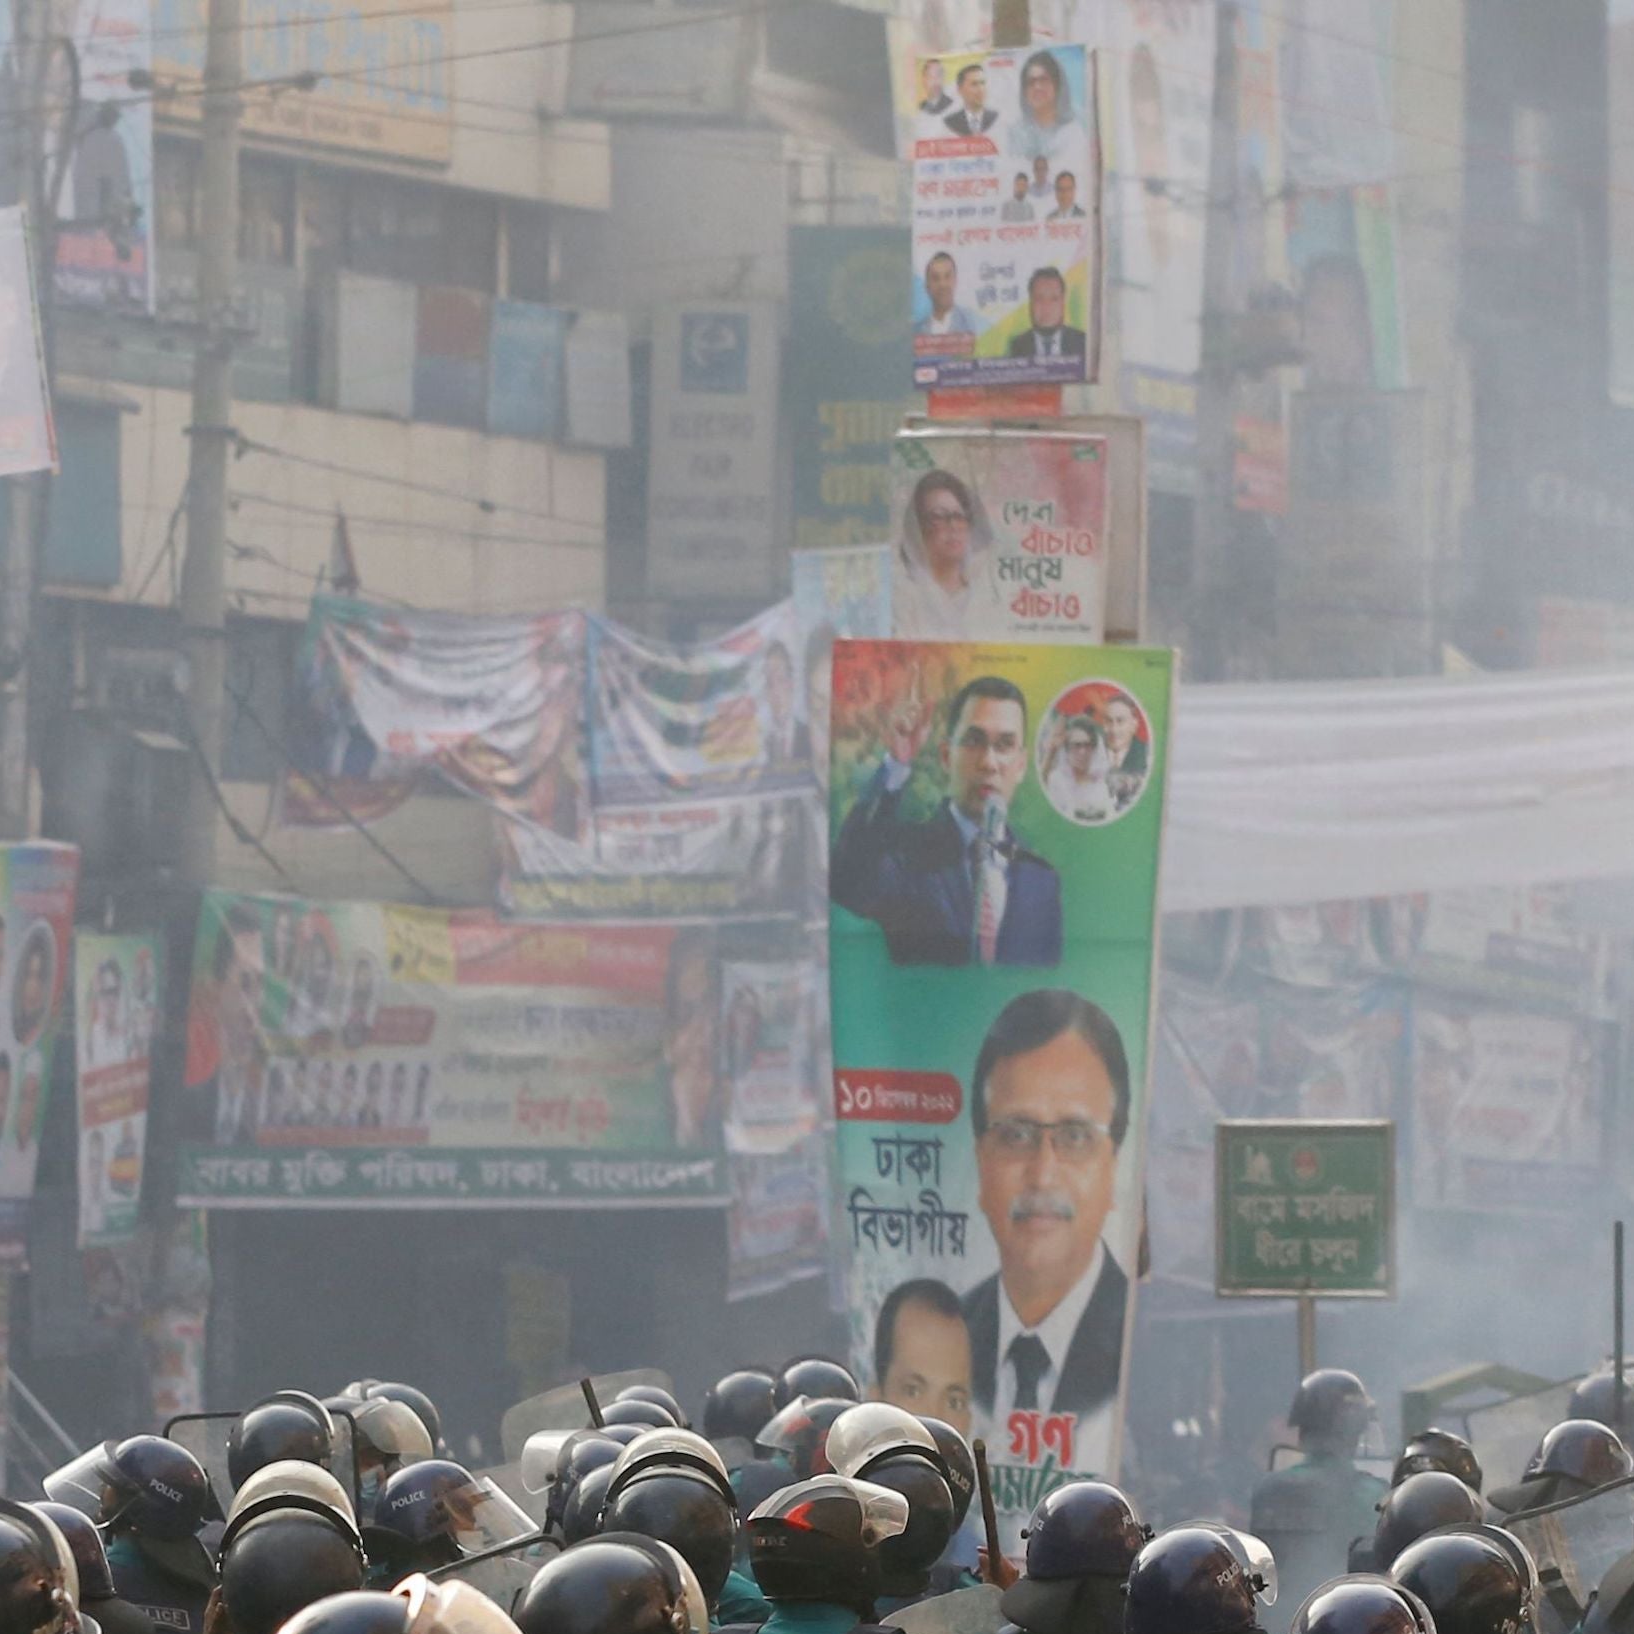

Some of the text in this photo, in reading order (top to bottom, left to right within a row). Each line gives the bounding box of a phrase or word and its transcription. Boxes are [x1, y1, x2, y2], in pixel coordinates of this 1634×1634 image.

[1002, 502, 1054, 526] দেশ
[1021, 524, 1094, 557] বাঁচাও
[997, 557, 1063, 590] মানুষ
[1010, 587, 1081, 620] বাঁচাও
[838, 1078, 875, 1114] ১০
[281, 1150, 346, 1192] মুক্তি
[871, 1131, 945, 1188] ঢাকা
[846, 1185, 969, 1258] বিভাগীয়
[1006, 1410, 1078, 1469] গণ
[148, 1477, 184, 1503] POLICE
[390, 1489, 427, 1511] POLICE
[1216, 1561, 1240, 1587] POLICE
